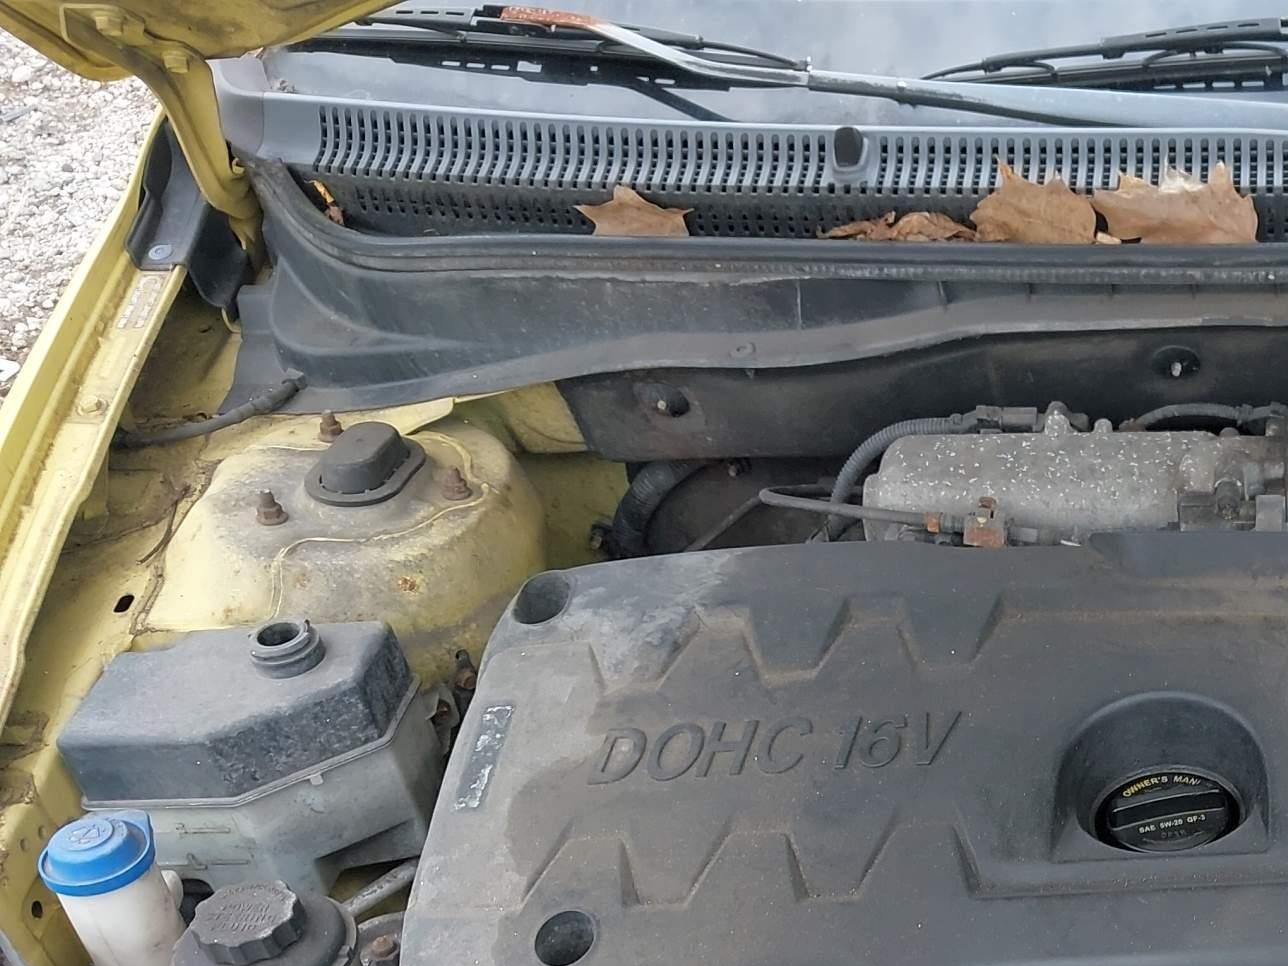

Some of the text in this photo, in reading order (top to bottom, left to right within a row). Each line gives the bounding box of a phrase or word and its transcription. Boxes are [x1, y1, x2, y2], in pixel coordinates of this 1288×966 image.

[587, 711, 962, 785] DOHC 16V
[1122, 775, 1168, 798] OWNER'S
[1139, 824, 1156, 834] SAE
